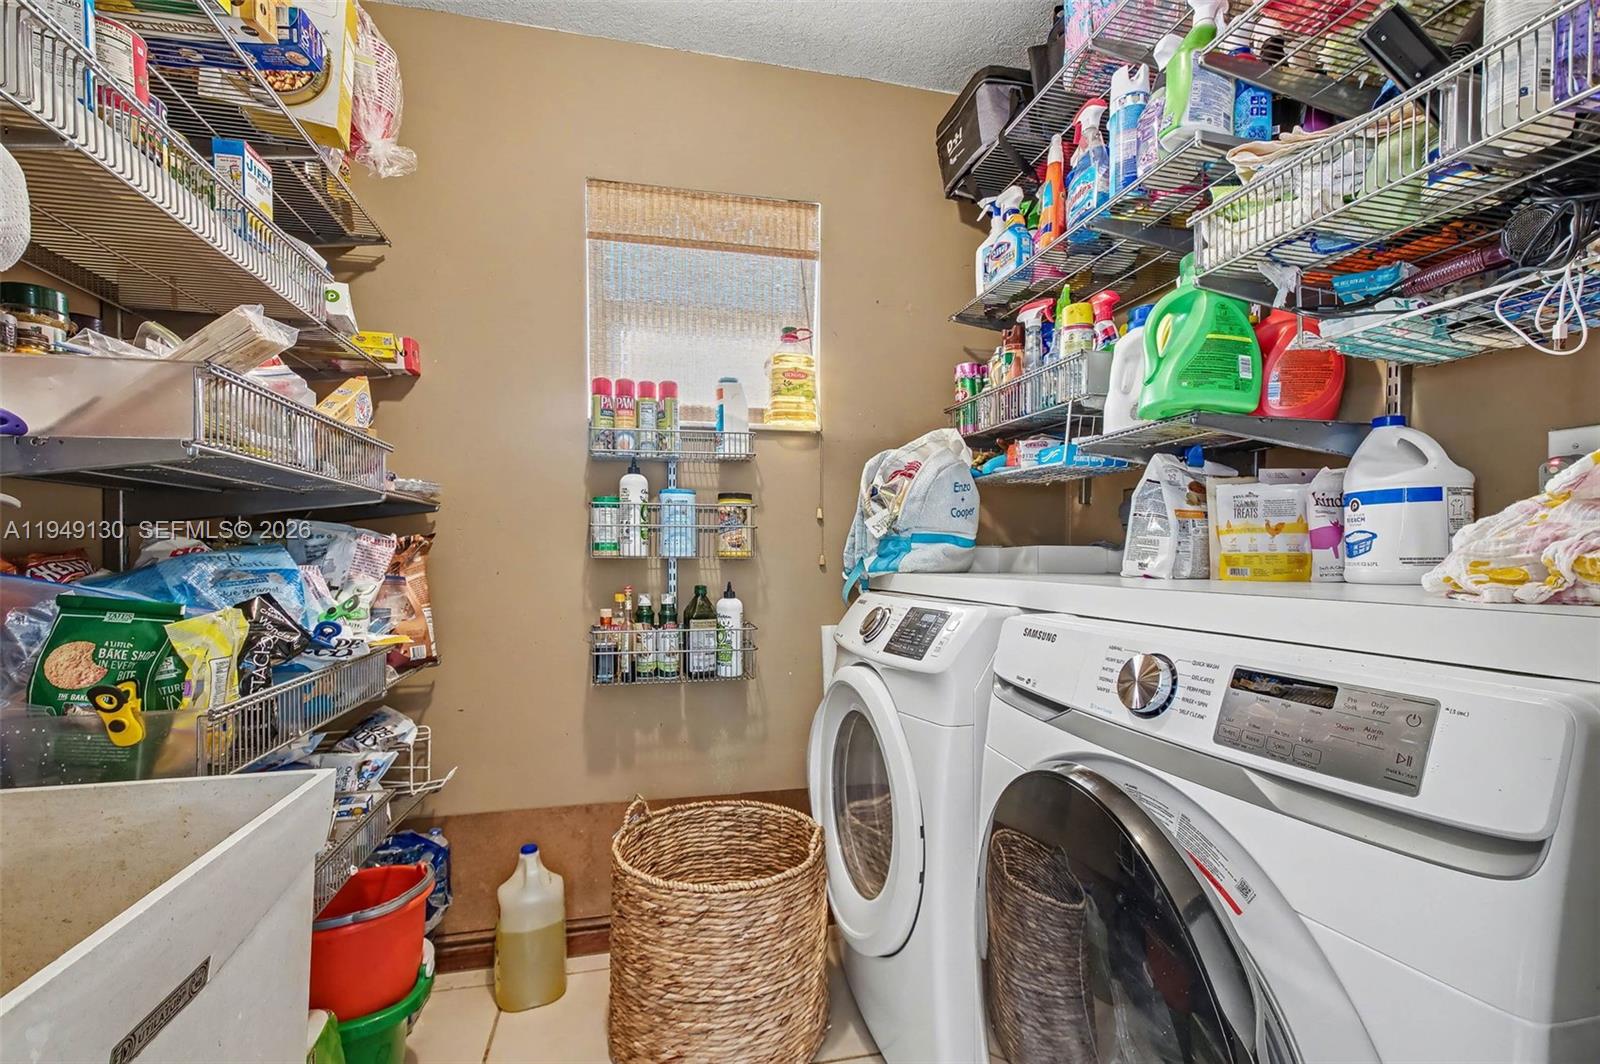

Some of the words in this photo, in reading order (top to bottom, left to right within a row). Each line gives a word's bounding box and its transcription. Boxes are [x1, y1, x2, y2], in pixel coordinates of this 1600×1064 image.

[246, 158, 272, 189] JIFFY
[616, 396, 635, 410] PAM
[953, 481, 971, 493] Enzo
[950, 507, 975, 519] Cooper
[1233, 508, 1259, 519] TREATS
[1023, 627, 1058, 643] SAMSUNG
[98, 648, 129, 660] BAKE
[131, 650, 156, 661] SHOP
[111, 661, 137, 670] EVERY
[116, 670, 136, 681] BITE
[57, 693, 67, 701] THE
[1371, 700, 1389, 710] Delay
[1372, 708, 1386, 717] End
[1364, 726, 1384, 736] Alarm
[1366, 732, 1378, 742] Off
